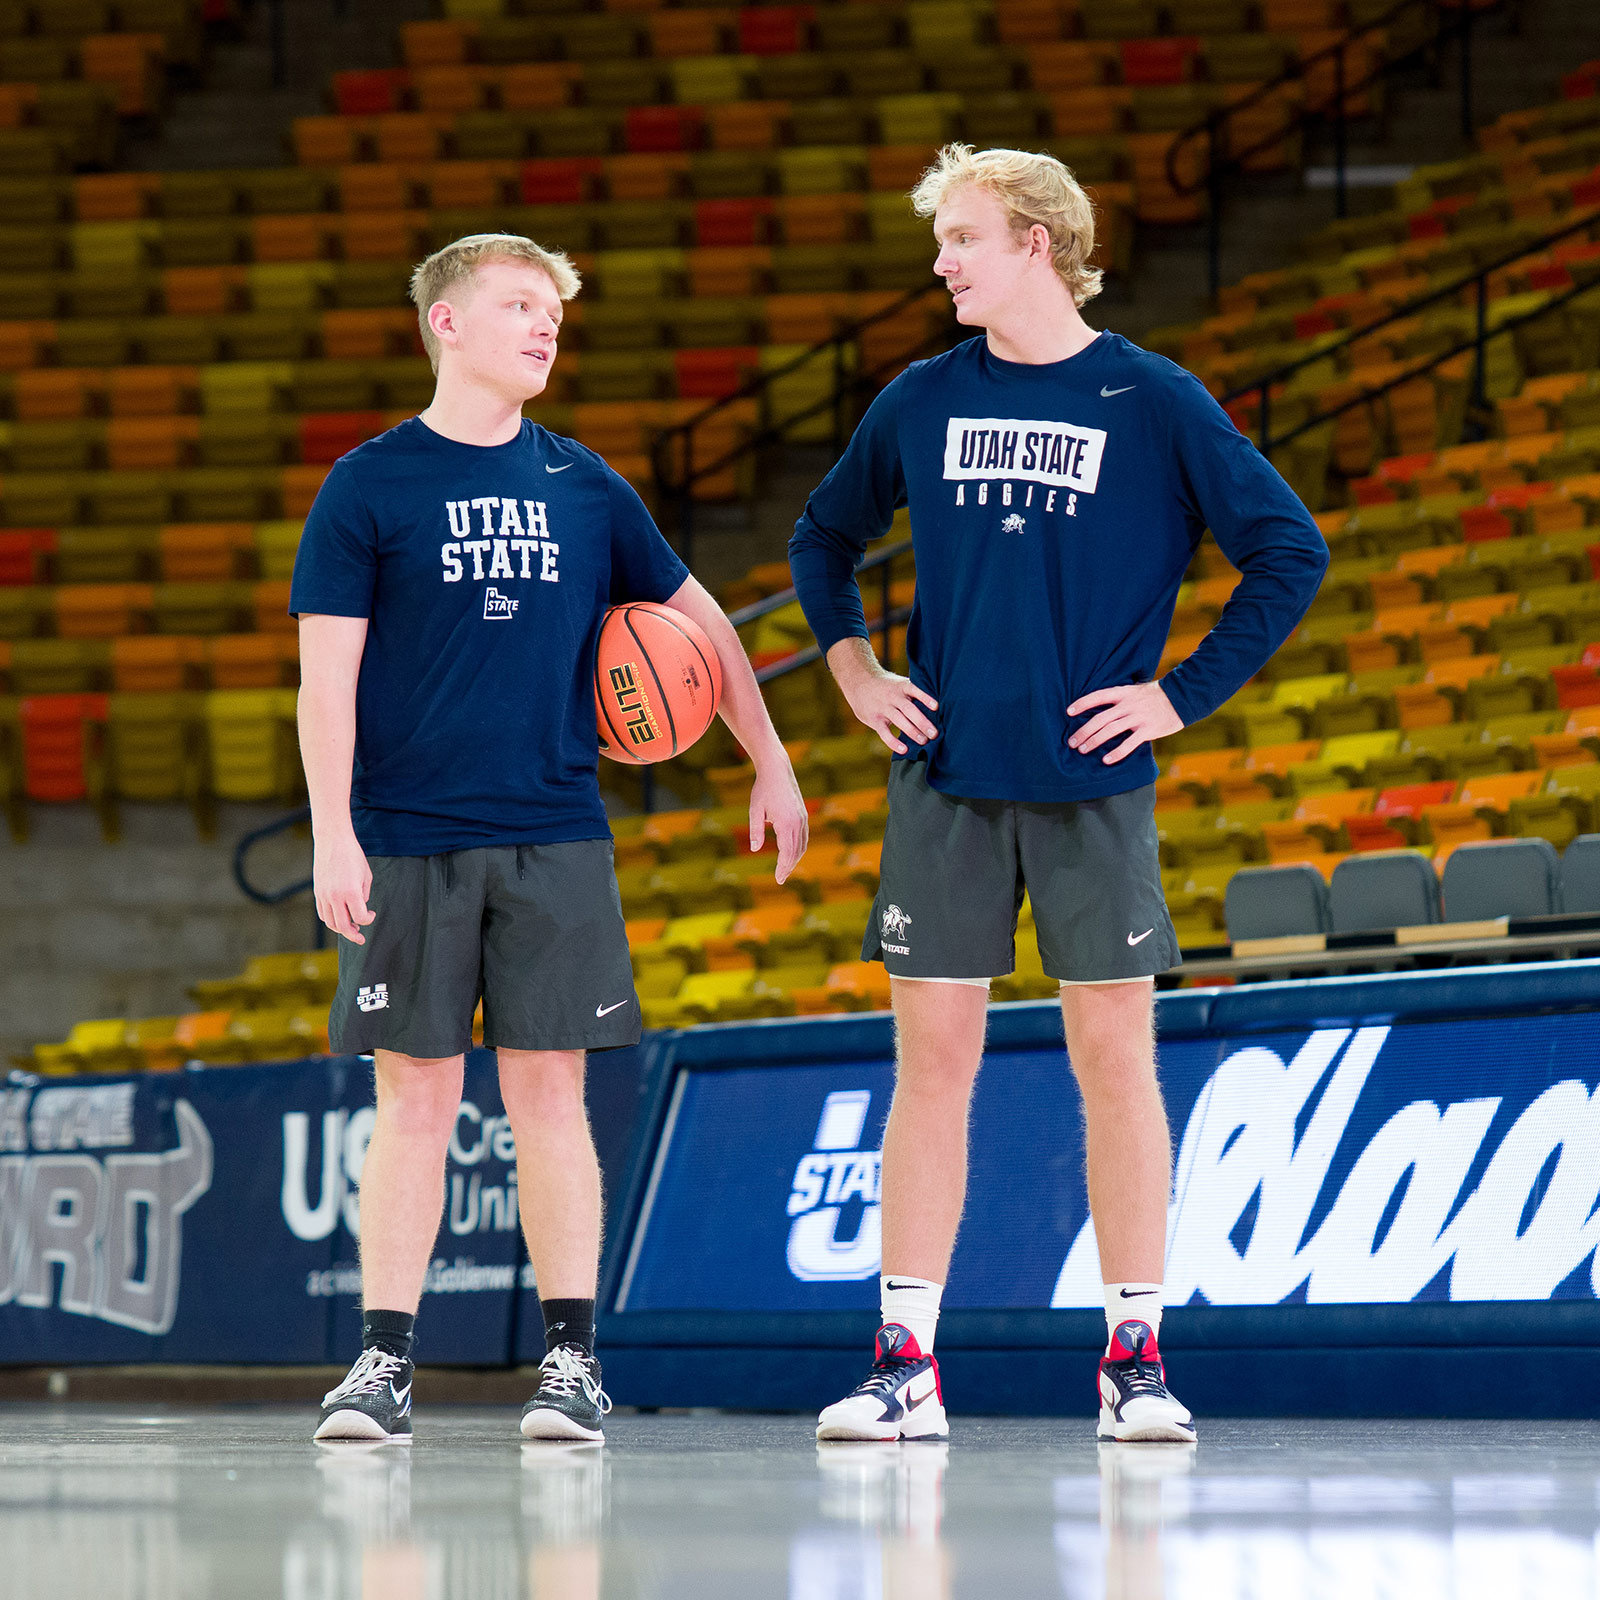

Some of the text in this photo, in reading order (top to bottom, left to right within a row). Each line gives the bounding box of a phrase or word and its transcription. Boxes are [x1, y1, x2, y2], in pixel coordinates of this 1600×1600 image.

[959, 430, 1089, 480] UTAH STATE
[445, 497, 550, 538] UTAH
[955, 483, 1077, 517] AGGIES
[441, 538, 560, 583] STATE
[487, 600, 519, 611] STATE
[608, 662, 656, 745] ELITE
[630, 661, 663, 739] CHAMPIONSHIP
[449, 1100, 517, 1166] Cre
[281, 1106, 378, 1242] US
[451, 1169, 519, 1236] Uni
[786, 1150, 882, 1217] STA
